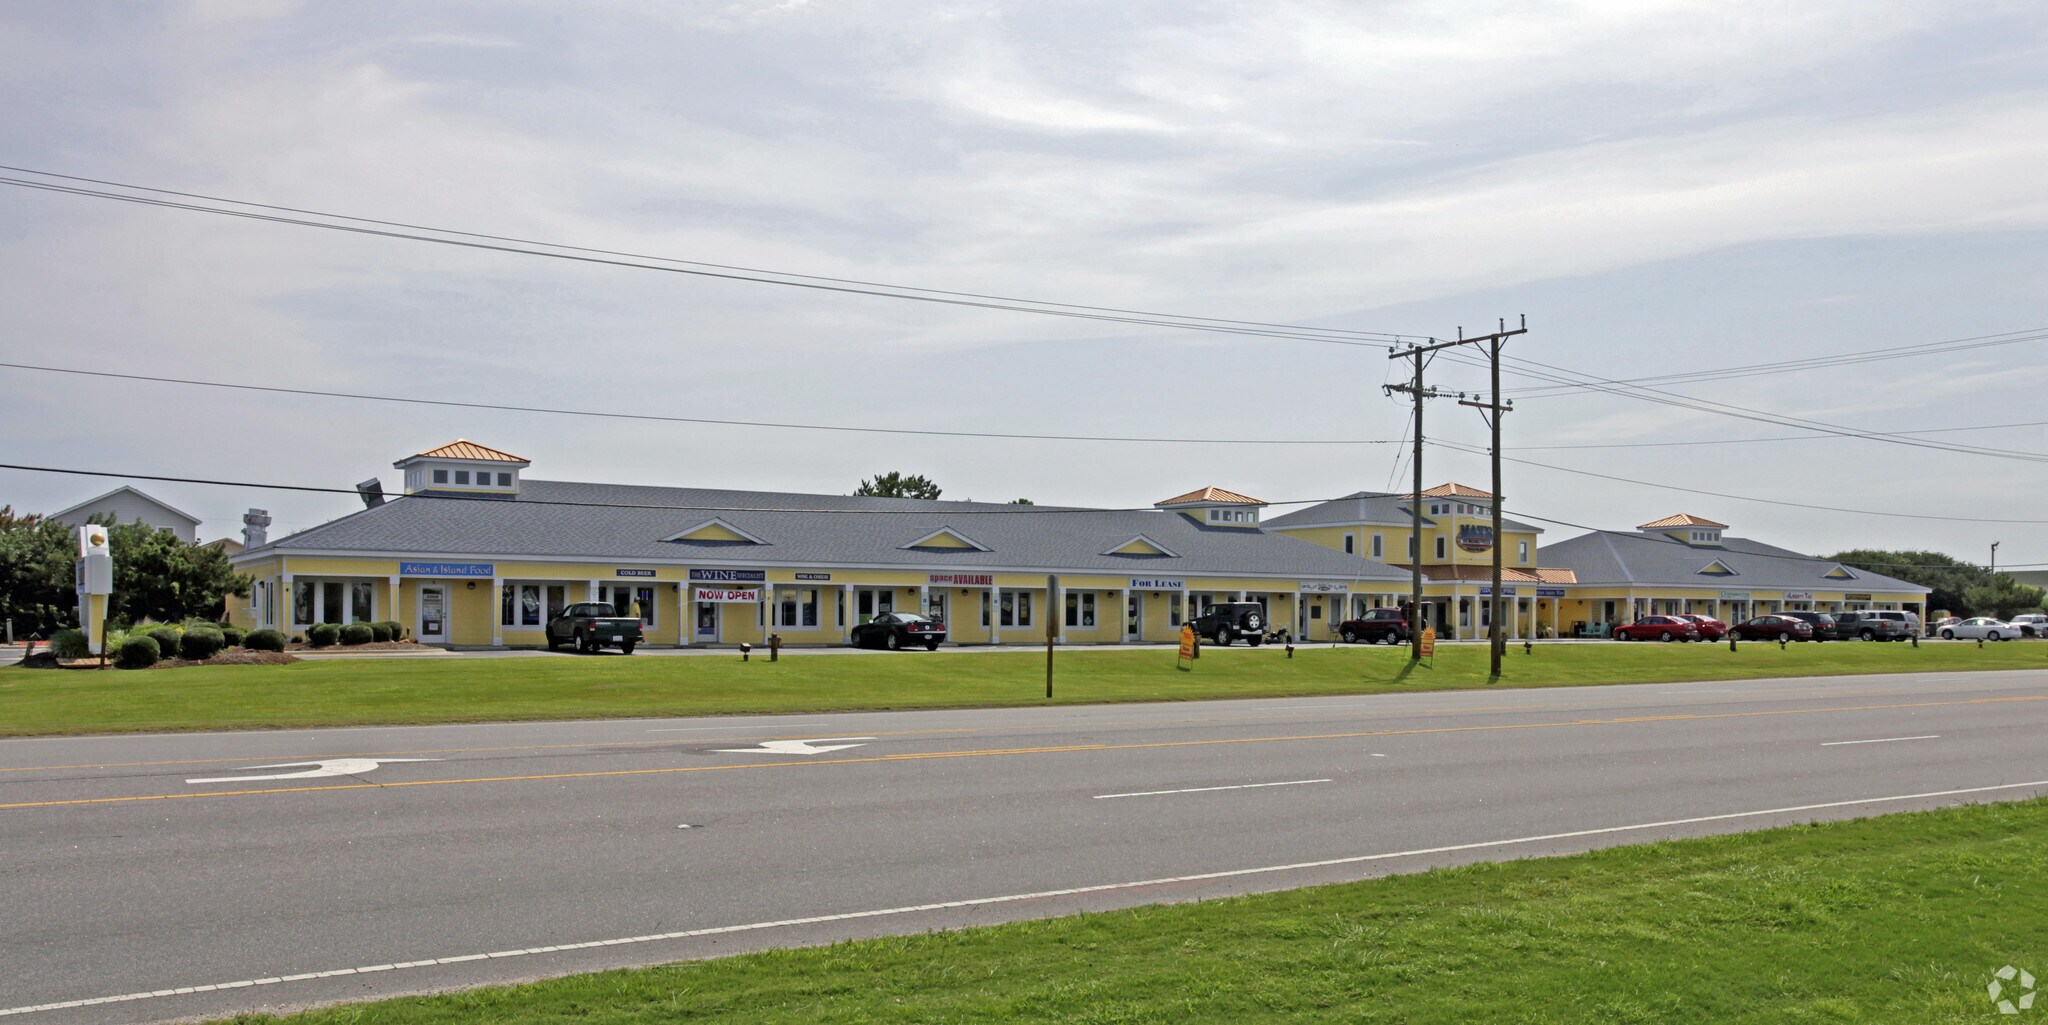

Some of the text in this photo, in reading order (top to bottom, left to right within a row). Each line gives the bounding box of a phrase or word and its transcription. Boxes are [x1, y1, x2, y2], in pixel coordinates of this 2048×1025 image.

[404, 564, 431, 573] Asian
[440, 565, 467, 574] Island
[470, 566, 491, 574] Food
[700, 570, 737, 580] WINE
[930, 574, 993, 585] space AVAILABLE
[1132, 579, 1184, 588] FOR LEASE
[698, 590, 755, 600] NOW OPEN
